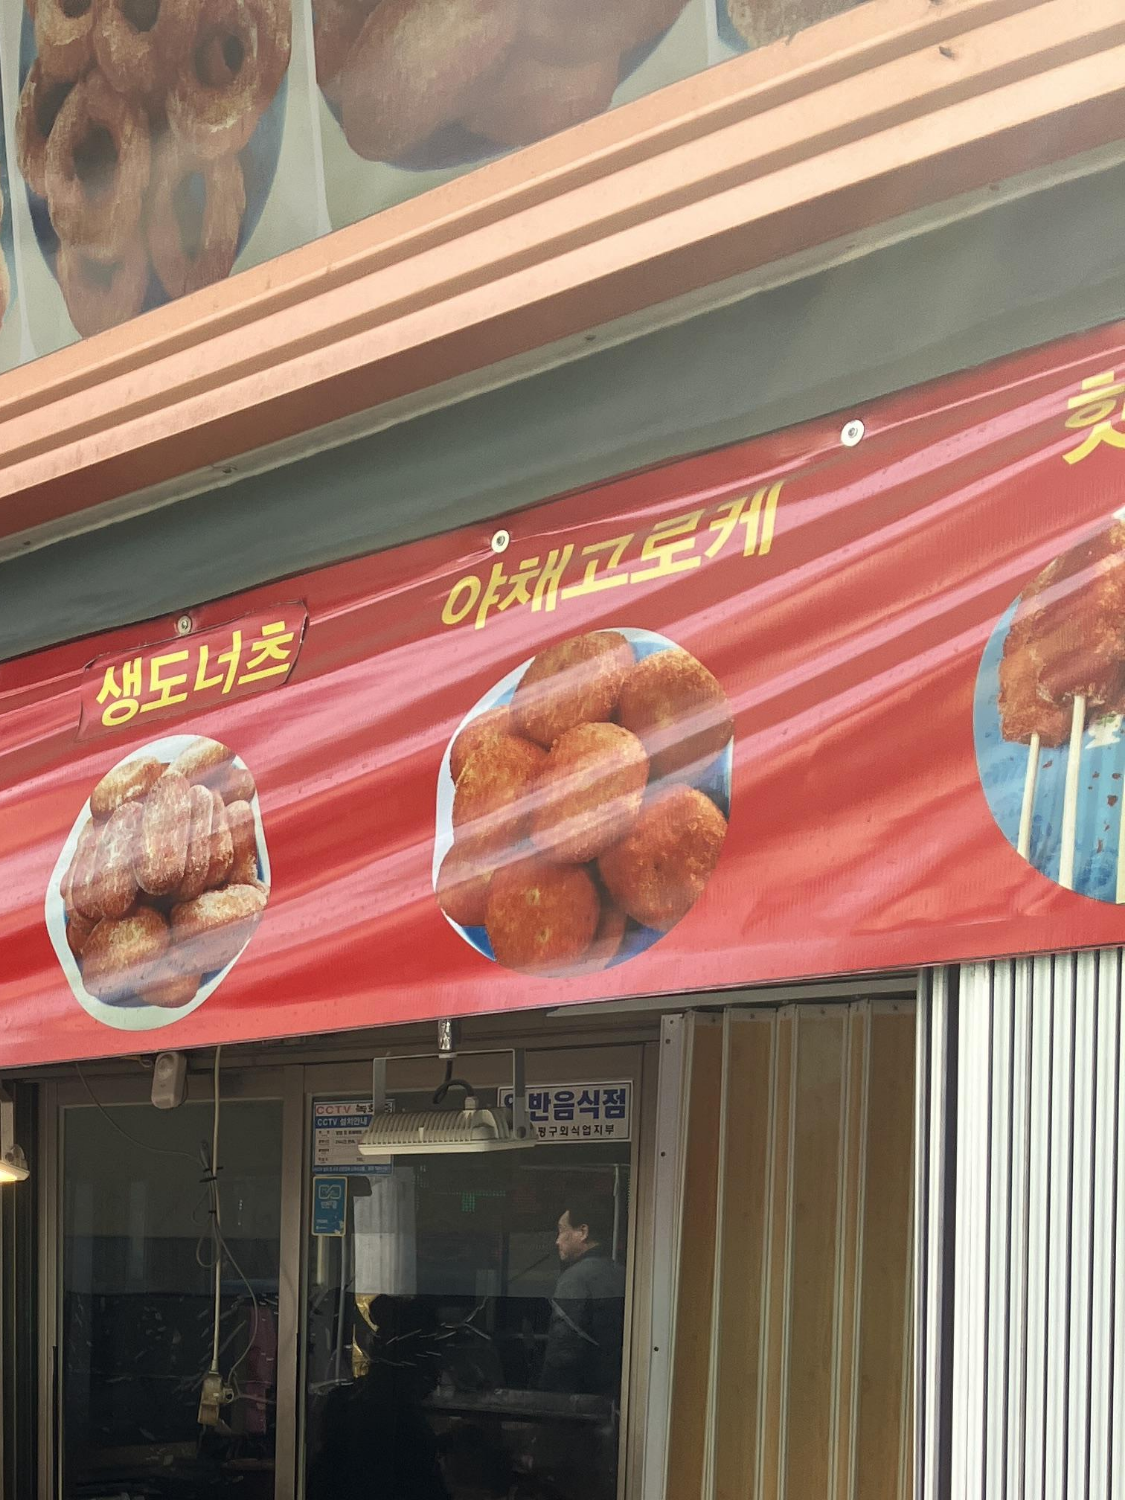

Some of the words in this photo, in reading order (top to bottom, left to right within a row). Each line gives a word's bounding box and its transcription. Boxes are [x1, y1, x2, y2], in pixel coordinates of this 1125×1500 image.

[441, 479, 785, 629] 야채고로케
[96, 621, 294, 727] 생도너츠
[316, 1105, 351, 1115] CCTV
[317, 1118, 338, 1126] CCTV
